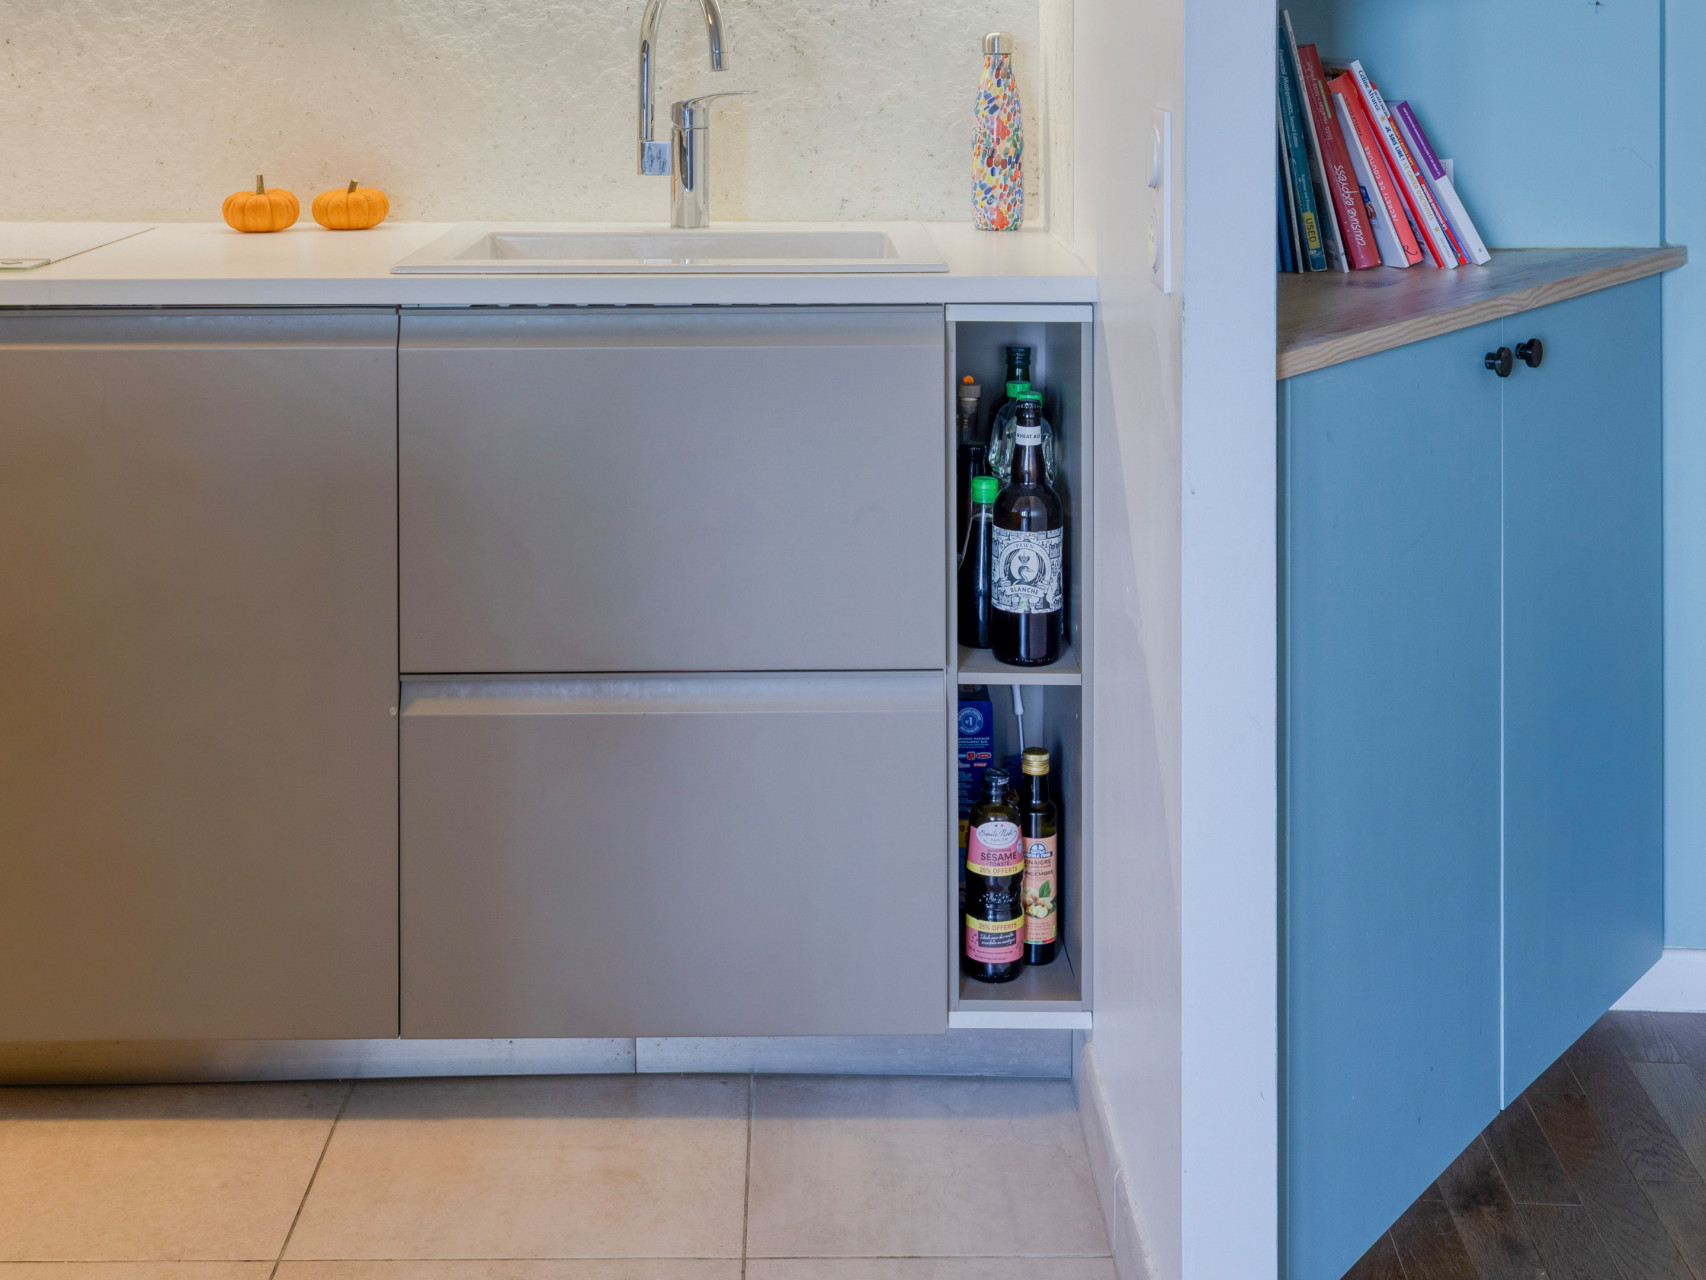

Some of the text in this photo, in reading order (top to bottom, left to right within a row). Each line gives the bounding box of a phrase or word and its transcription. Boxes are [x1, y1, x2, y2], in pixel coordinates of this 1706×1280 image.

[1279, 49, 1287, 75] Financial
[1358, 70, 1370, 89] Céline
[1367, 87, 1380, 111] Alvarez
[1388, 133, 1398, 146] SAIS
[1403, 162, 1410, 171] LE
[1408, 171, 1419, 190] CAHIER
[1364, 146, 1380, 180] COUTURE
[1379, 181, 1386, 191] DE
[1333, 164, 1366, 247] cuisine express
[1305, 217, 1317, 243] USED
[1010, 587, 1039, 595] BLANCHE
[980, 852, 1017, 861] SÉSAME
[992, 865, 1018, 874] OFFERTS
[992, 922, 1017, 931] OFFERTS
